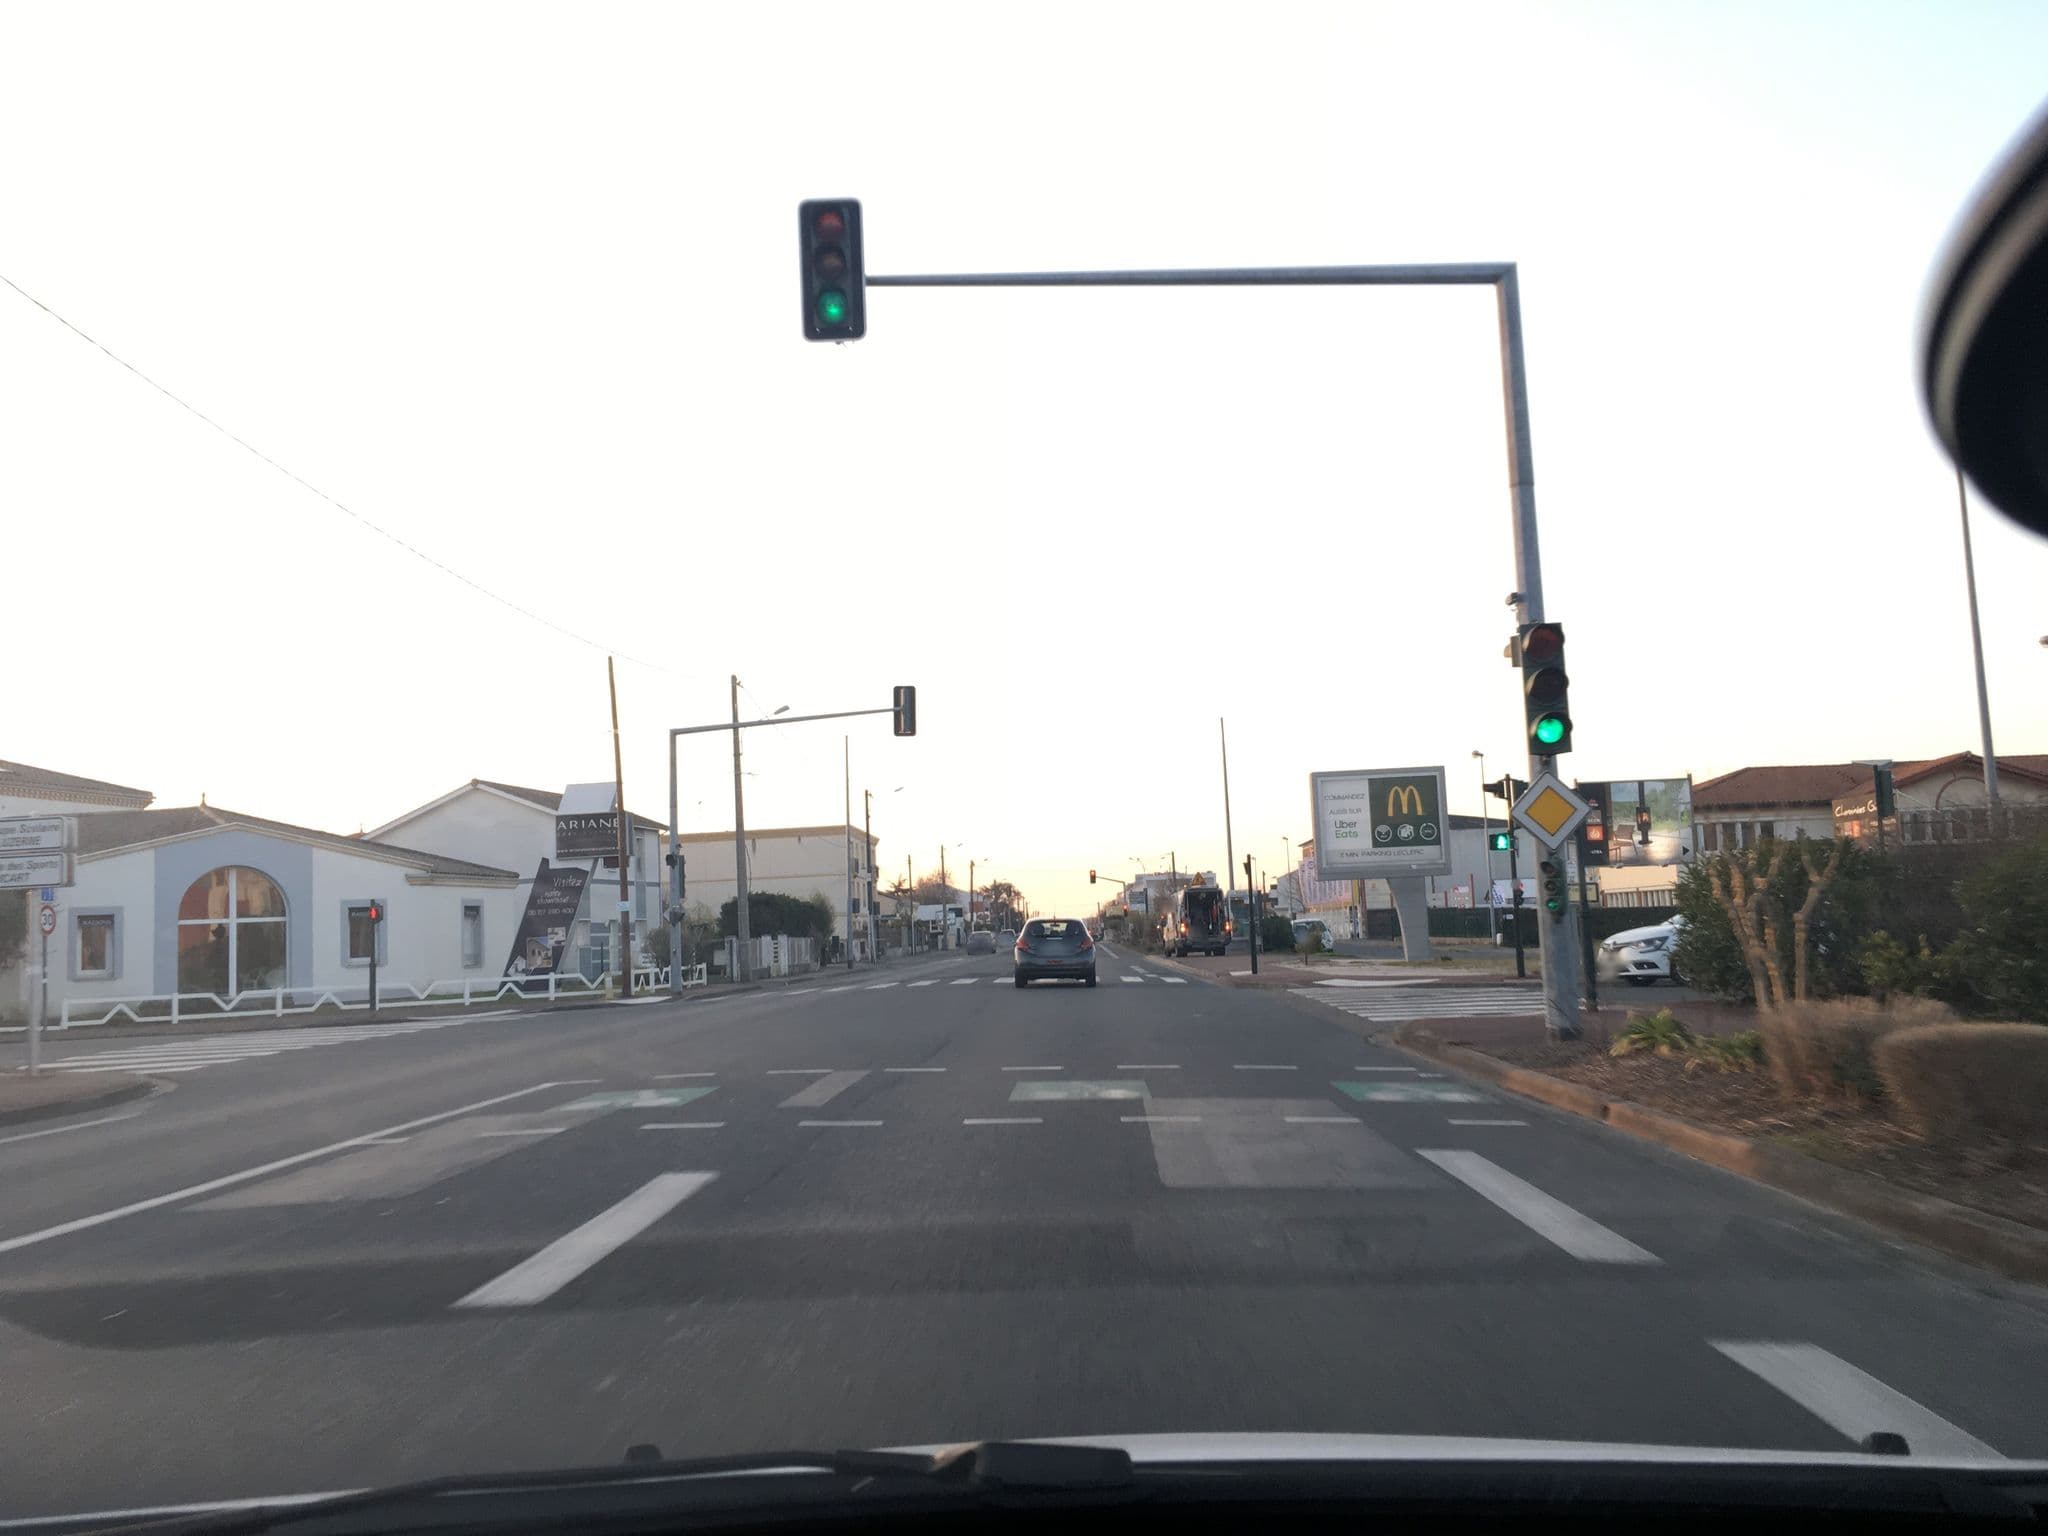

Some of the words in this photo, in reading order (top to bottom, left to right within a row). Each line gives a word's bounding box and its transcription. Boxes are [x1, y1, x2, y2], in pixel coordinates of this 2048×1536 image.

[1334, 820, 1358, 830] Uber
[1335, 830, 1359, 839] Eats
[42, 914, 52, 926] 30
